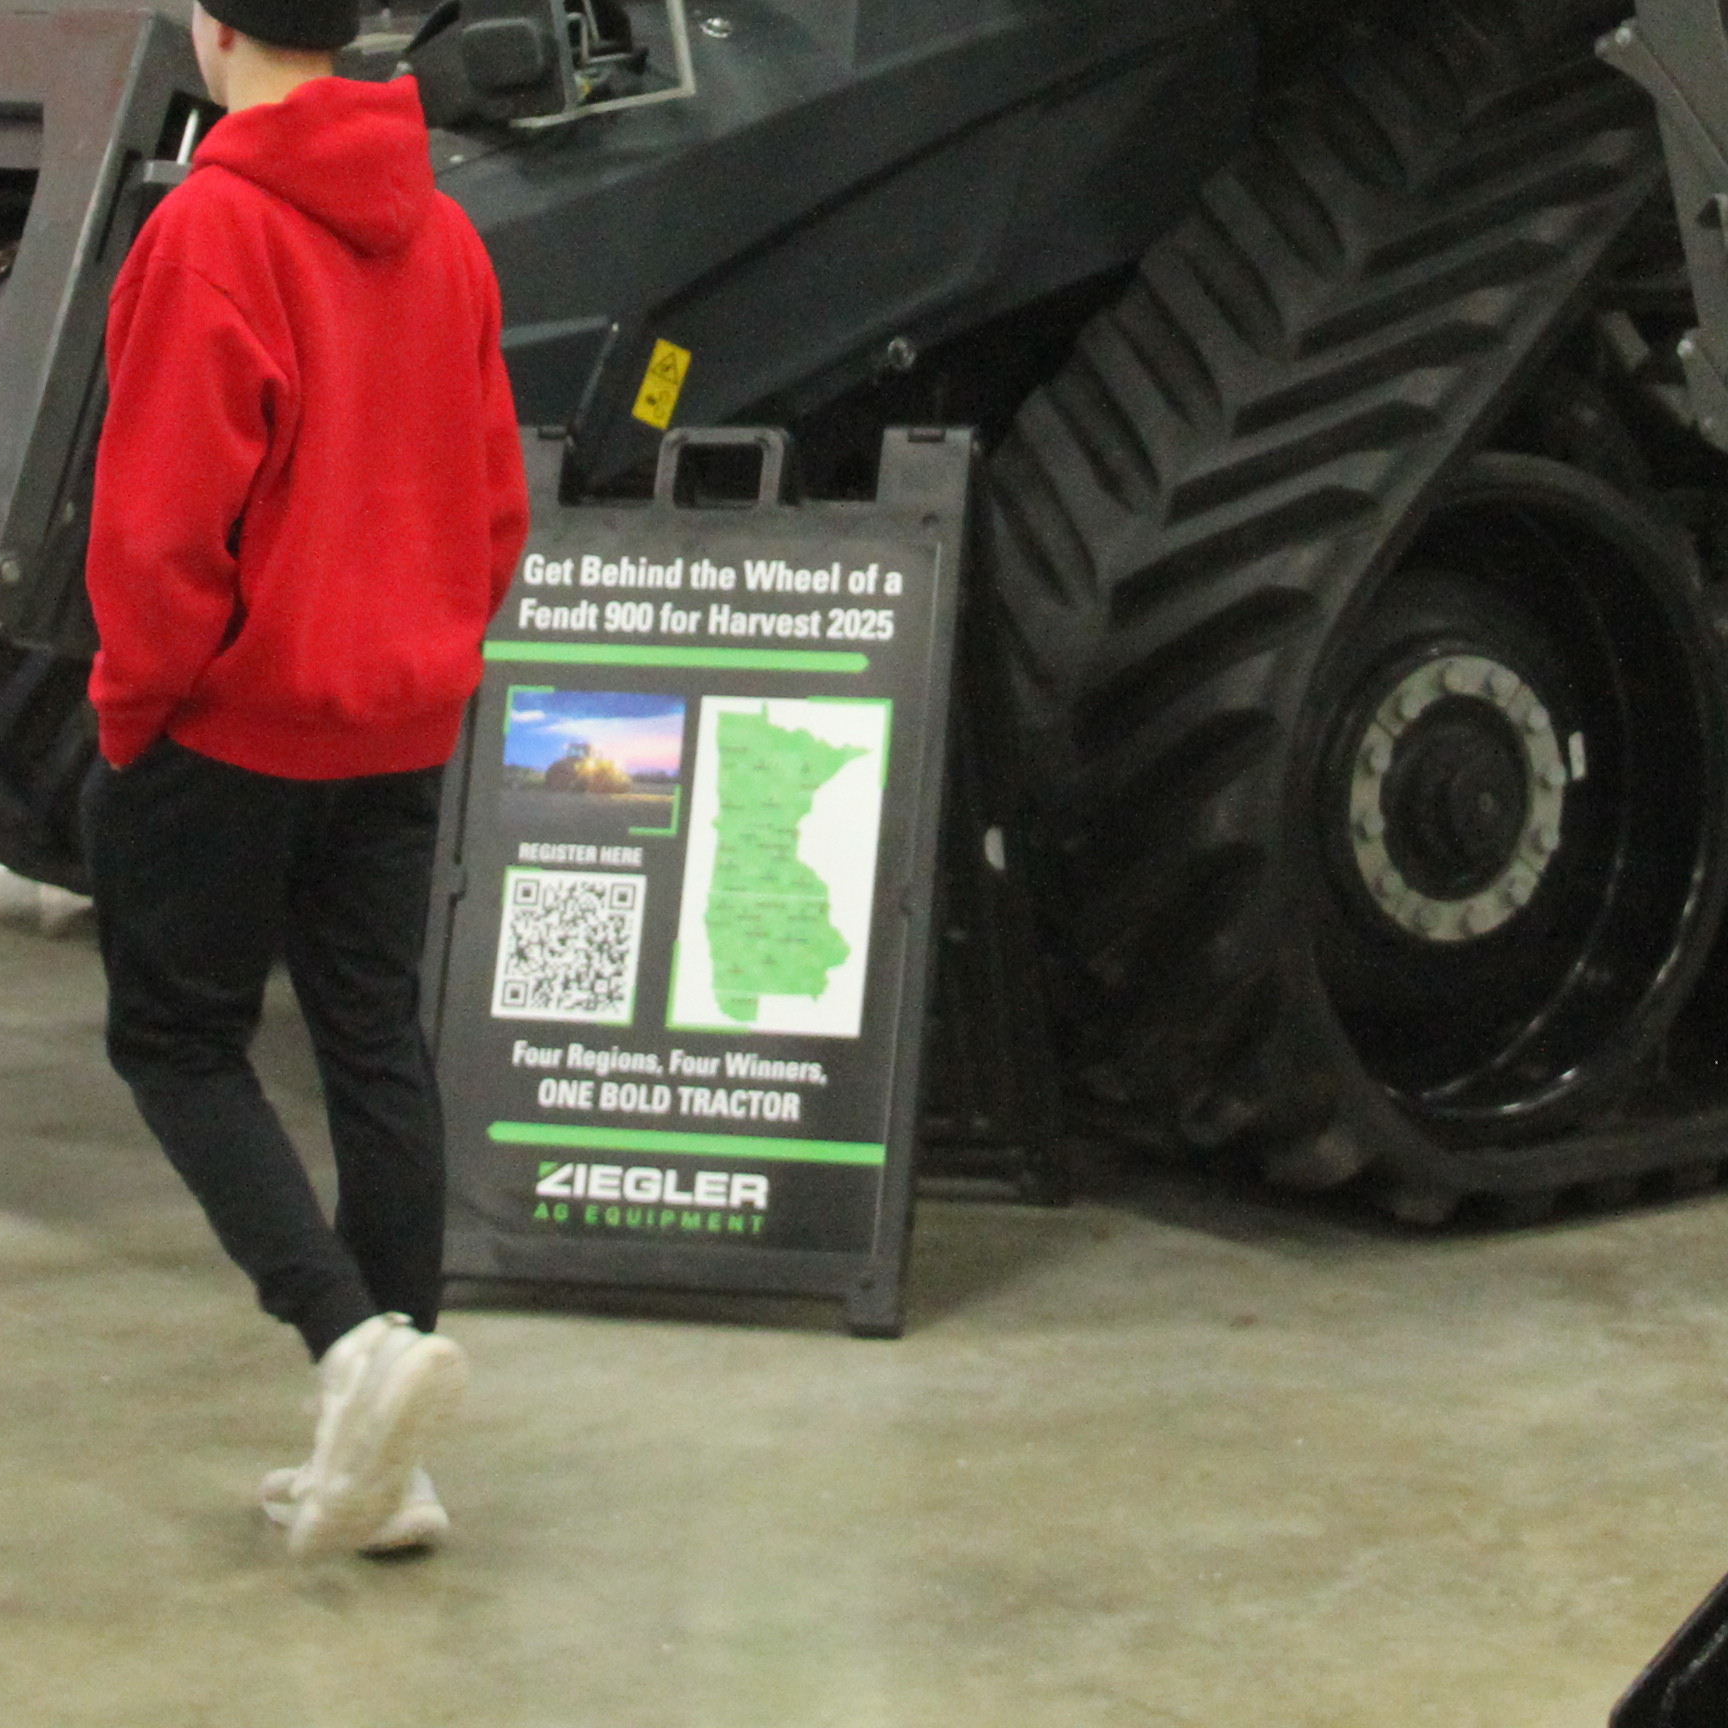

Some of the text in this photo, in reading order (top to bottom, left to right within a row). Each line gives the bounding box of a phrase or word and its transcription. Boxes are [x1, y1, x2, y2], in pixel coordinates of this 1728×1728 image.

[523, 553, 903, 596] Get Behind the Wheel of a
[518, 597, 895, 641] Fendt 900 for Harvest 2025
[518, 842, 643, 866] REGISTER HERE
[512, 1040, 828, 1086] Four Regions, Four Winners,
[537, 1078, 801, 1122] ONE BOLD TRACTOR
[535, 1161, 769, 1210] ZIEGLER
[533, 1202, 766, 1235] AG EQUIPMENT
